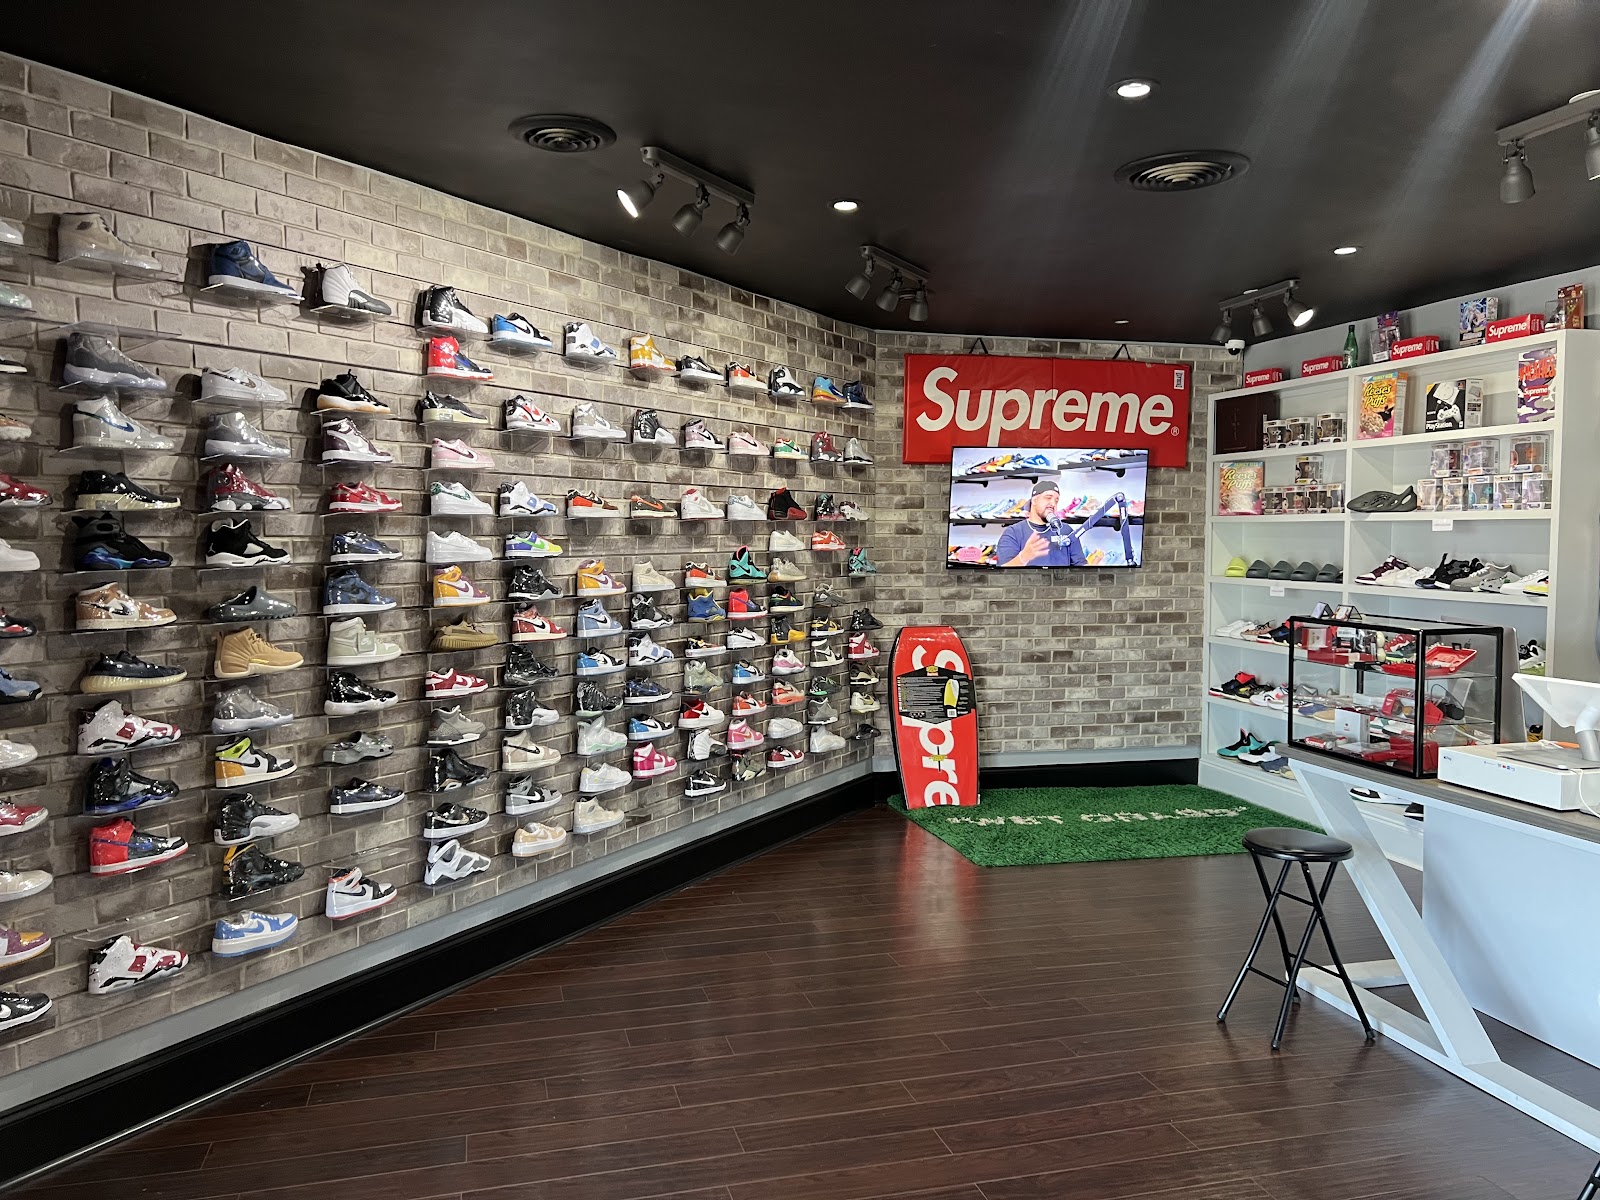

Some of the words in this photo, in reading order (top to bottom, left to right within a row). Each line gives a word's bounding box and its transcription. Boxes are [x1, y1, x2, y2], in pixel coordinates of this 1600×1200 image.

[1488, 321, 1527, 338] Supreme
[1392, 342, 1423, 358] Supreme
[1302, 361, 1329, 374] Supreme
[1245, 373, 1270, 385] Supreme
[1524, 387, 1548, 396] Supreme
[916, 366, 1175, 447] Supreme
[1364, 396, 1387, 409] Puffs
[1426, 421, 1453, 431] PlayStation
[1227, 479, 1253, 490] Puffs
